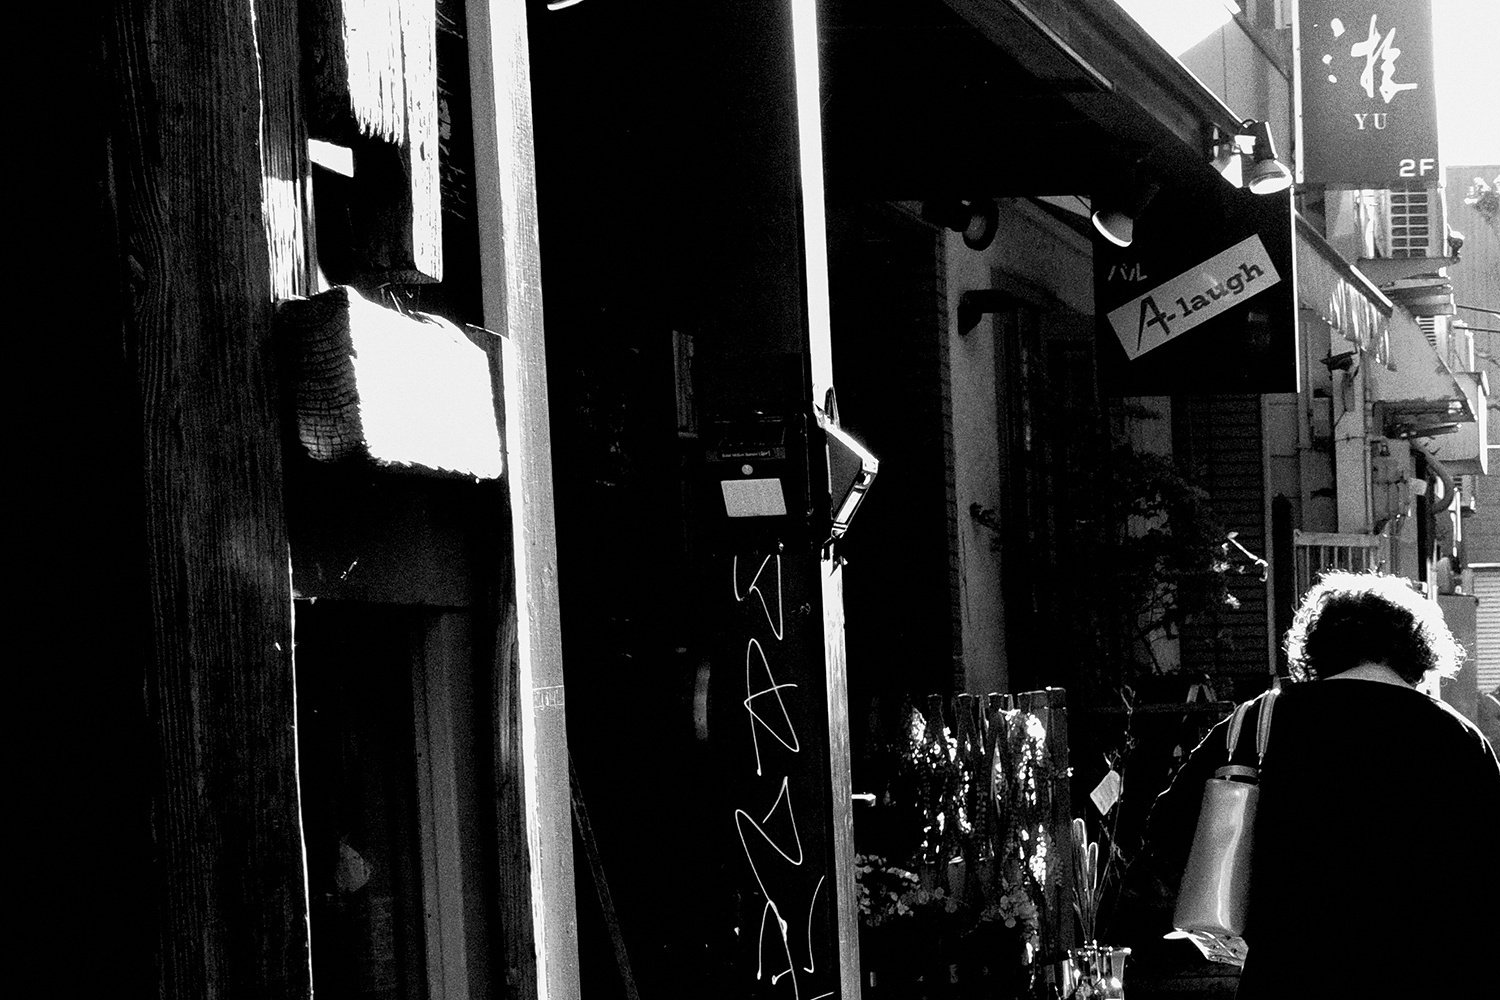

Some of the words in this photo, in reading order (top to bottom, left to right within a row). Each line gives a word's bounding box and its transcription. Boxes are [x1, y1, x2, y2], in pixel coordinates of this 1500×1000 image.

[1354, 113, 1388, 130] YU
[1399, 158, 1435, 177] 2F
[1107, 262, 1148, 282] バル
[1137, 262, 1265, 351] A-laugh
